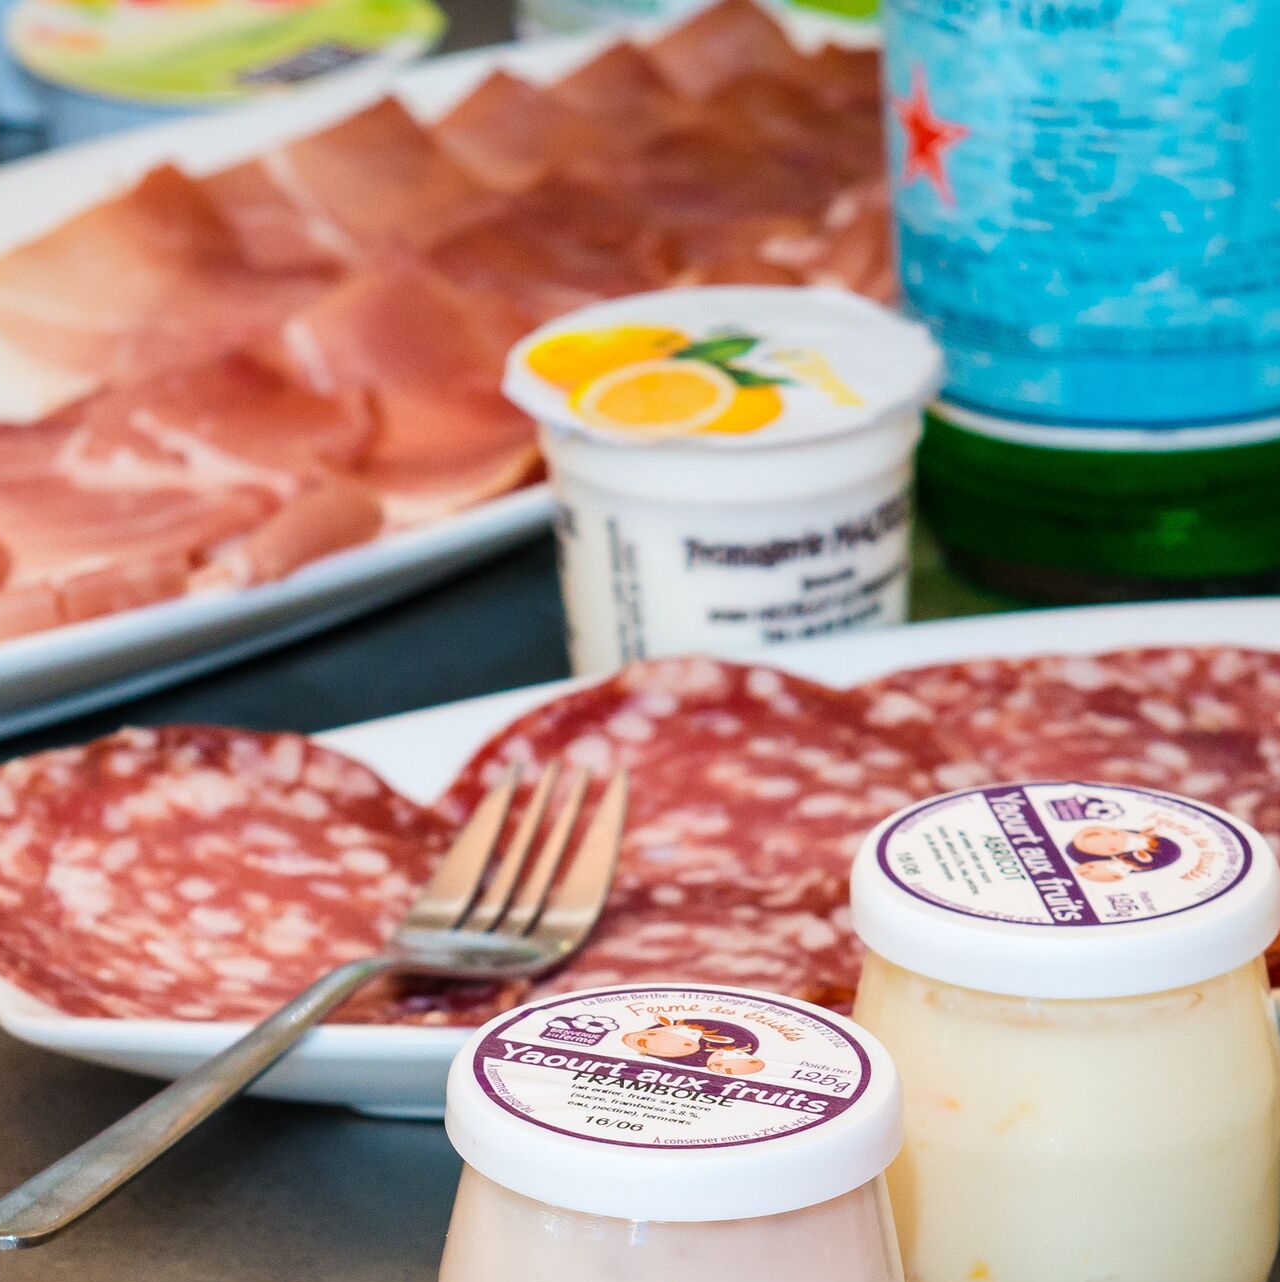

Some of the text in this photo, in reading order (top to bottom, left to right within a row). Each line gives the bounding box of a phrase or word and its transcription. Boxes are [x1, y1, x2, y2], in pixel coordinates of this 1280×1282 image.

[981, 834, 1025, 880] ABRICOT
[988, 790, 1082, 921] Yaourt aux fruits
[680, 992, 714, 1001] 41170
[625, 1002, 701, 1016] Ferme
[709, 1005, 736, 1016] des
[549, 1027, 602, 1040] BIENVENUE
[559, 1033, 596, 1044] ferme
[799, 1060, 832, 1071] Poids
[502, 1043, 829, 1113] Yaourt aux fruits
[790, 1069, 851, 1093] 125g
[572, 1071, 734, 1107] FRAMBOISE
[585, 1115, 645, 1132] 16/06
[664, 1136, 718, 1145] conserver
[721, 1132, 749, 1143] entre
